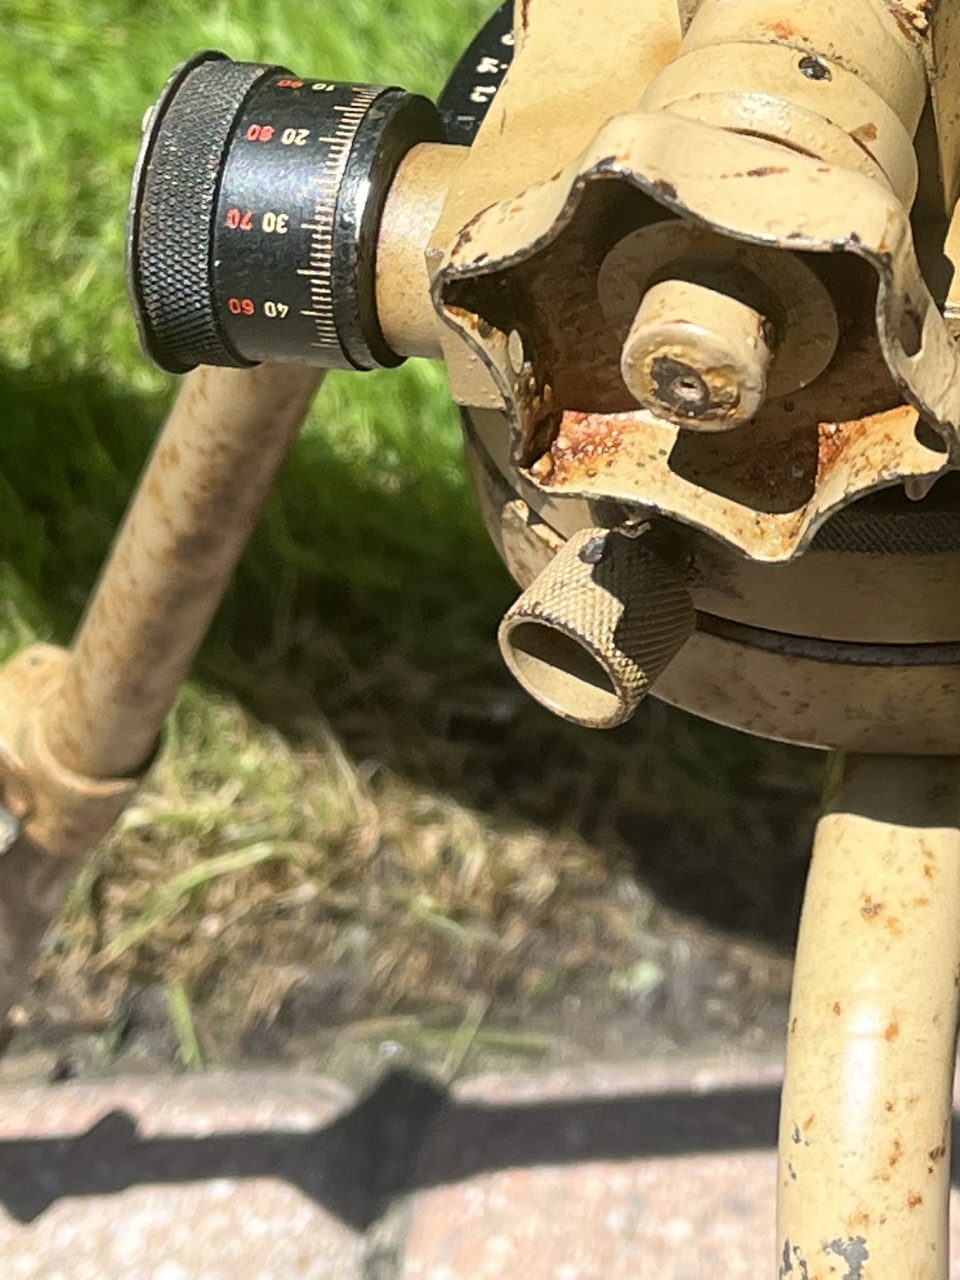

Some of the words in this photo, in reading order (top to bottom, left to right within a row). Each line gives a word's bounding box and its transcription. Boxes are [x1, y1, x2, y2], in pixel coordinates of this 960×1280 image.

[246, 124, 275, 143] 80
[281, 128, 310, 146] 20
[226, 208, 254, 230] 70
[262, 212, 289, 234] 30
[228, 298, 255, 315] 60
[264, 301, 289, 318] 40
